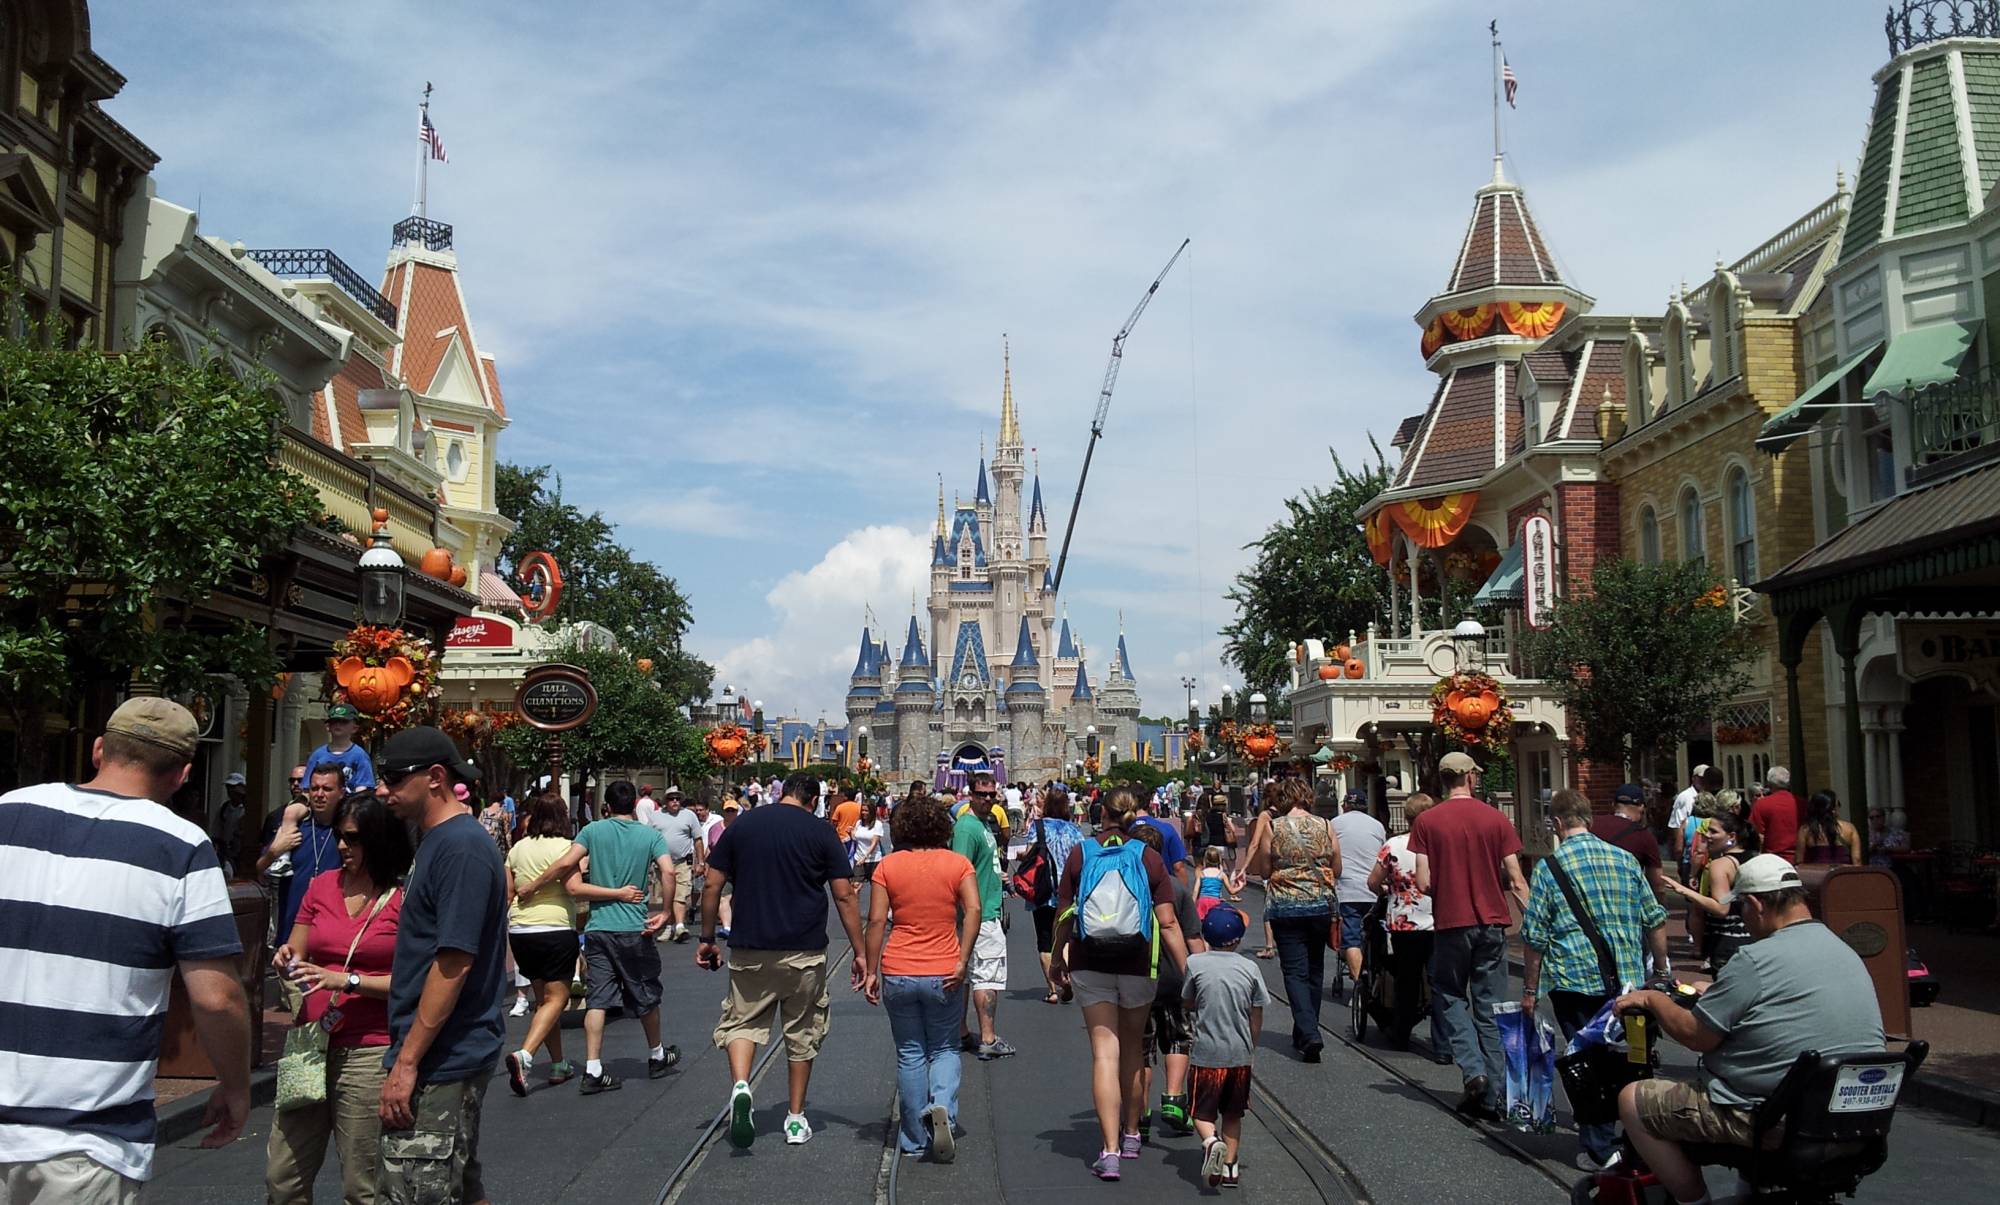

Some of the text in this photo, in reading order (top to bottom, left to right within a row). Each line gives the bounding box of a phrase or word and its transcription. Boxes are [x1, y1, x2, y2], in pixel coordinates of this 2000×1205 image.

[542, 685, 569, 693] HALL
[525, 697, 585, 706] CHAMPIONS
[1839, 1084, 1896, 1096] SCOOTER RENTALS
